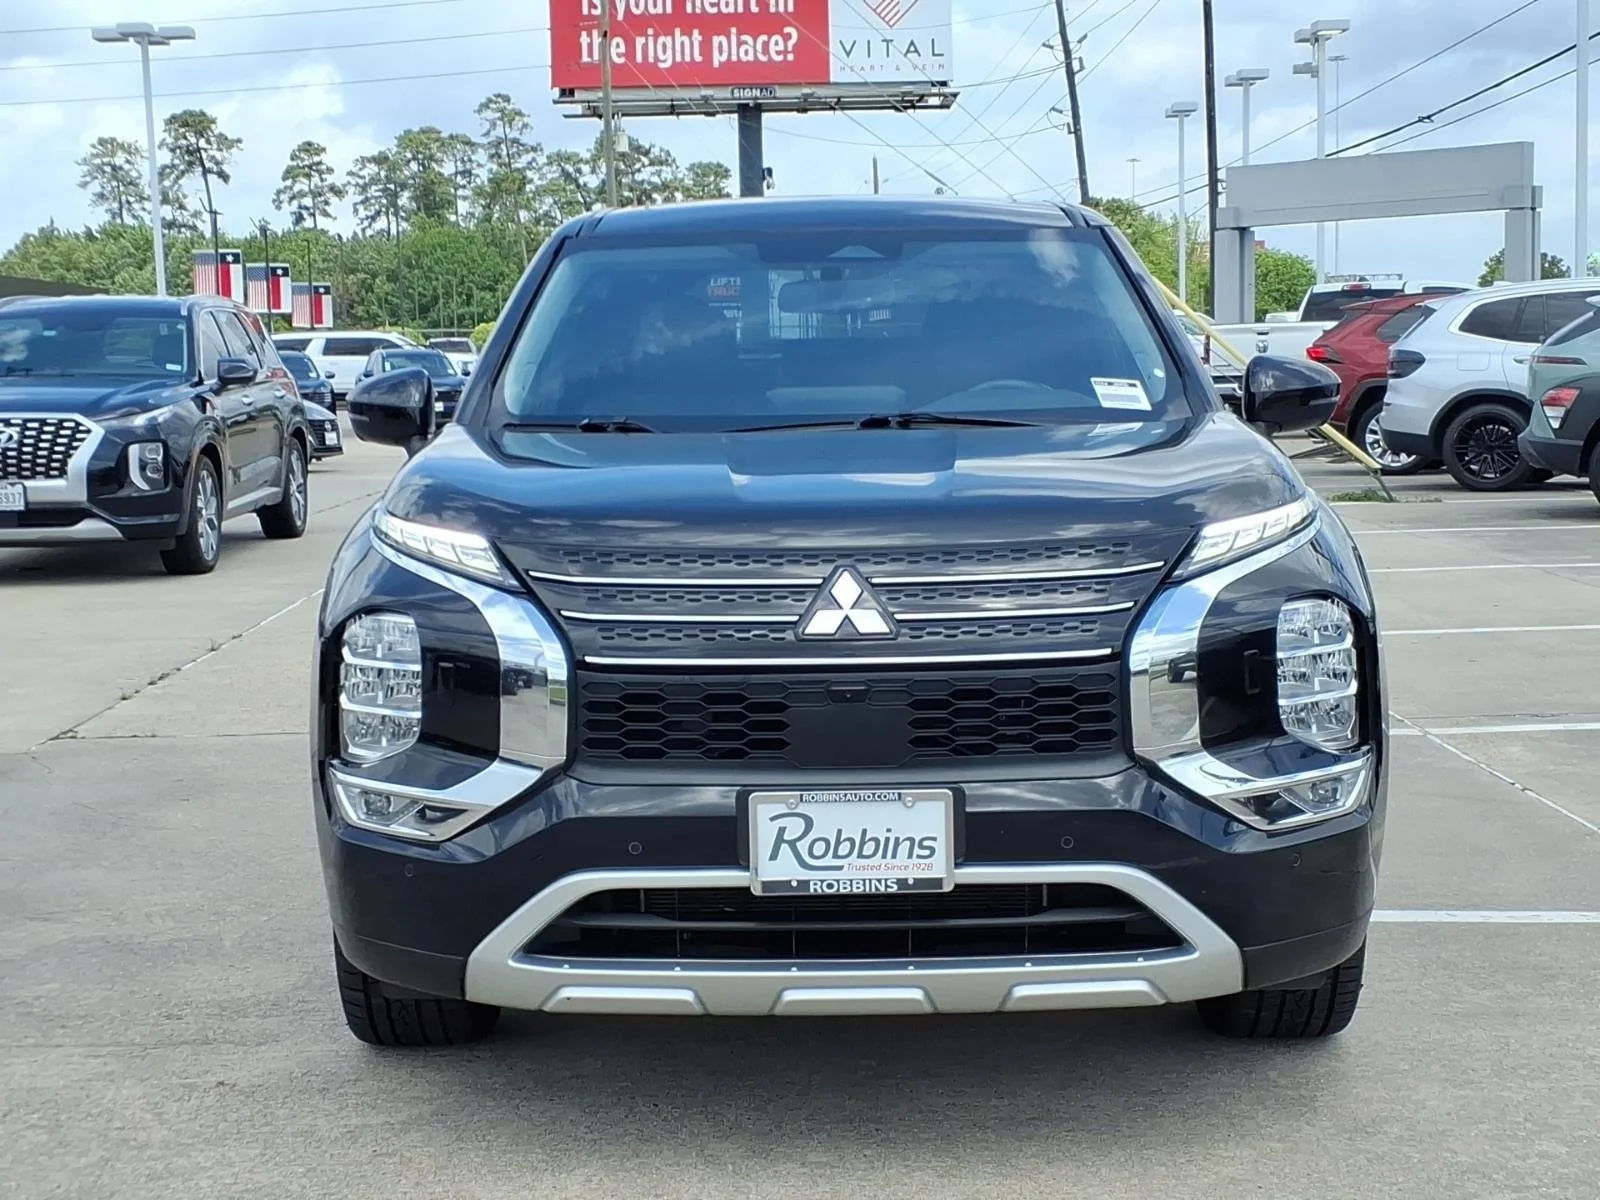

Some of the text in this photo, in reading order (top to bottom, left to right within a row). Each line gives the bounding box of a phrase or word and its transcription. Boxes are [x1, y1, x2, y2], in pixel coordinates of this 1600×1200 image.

[580, 26, 798, 68] the right place?
[839, 38, 945, 59] VITAL
[840, 64, 886, 73] HEART
[911, 62, 945, 72] VEIN
[802, 792, 899, 802] ROBBINSAUTO.COM
[768, 811, 938, 872] Robbins
[846, 862, 934, 872] Trusted Since 1928
[809, 879, 898, 893] ROBBINS
